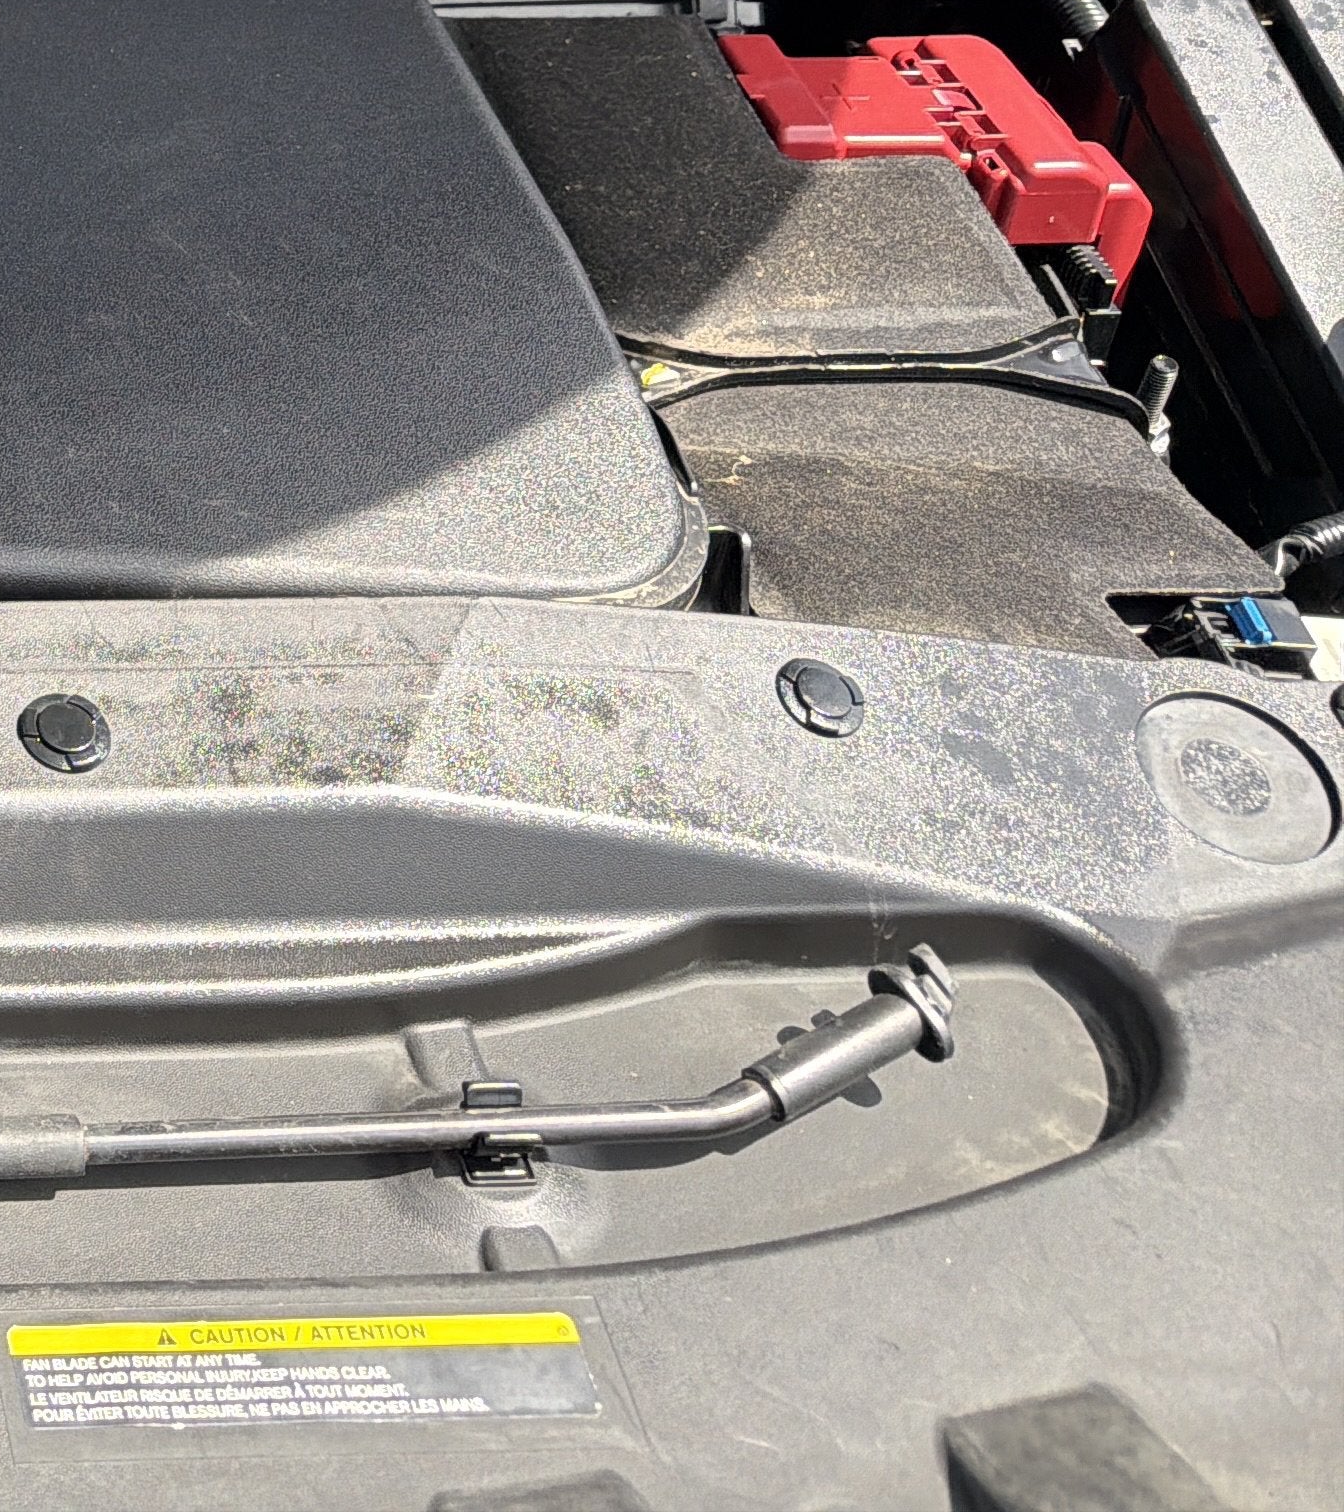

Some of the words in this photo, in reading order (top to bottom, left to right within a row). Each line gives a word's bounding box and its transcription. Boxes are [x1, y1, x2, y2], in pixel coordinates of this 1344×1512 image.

[190, 1327, 285, 1345] CAUTION
[294, 1327, 301, 1341] /
[312, 1323, 426, 1341] ATTENTION
[23, 1358, 50, 1371] FAN
[53, 1356, 96, 1371] BLADE
[99, 1356, 130, 1368] CAN
[132, 1356, 174, 1368] START
[177, 1356, 193, 1367] AT
[196, 1355, 224, 1367] ANY
[226, 1354, 261, 1366] TIME.
[26, 1375, 46, 1387] TO
[49, 1374, 82, 1387] HELP
[86, 1373, 128, 1386] AVOID
[131, 1370, 204, 1384] PERSONAL
[291, 1367, 339, 1380] HANDS
[341, 1366, 390, 1379] CLEAR.
[30, 1392, 47, 1406] LE
[50, 1389, 138, 1405] VENTILATEUR
[141, 1389, 192, 1402] RISQUE
[195, 1388, 214, 1401] DE
[217, 1384, 292, 1401] DÉMARRER
[307, 1384, 343, 1398] TOUT
[345, 1384, 409, 1398] MOMENT.
[33, 1409, 74, 1422] POUR
[77, 1405, 122, 1421] ÉVITER
[125, 1405, 170, 1420] TOUTE
[250, 1404, 270, 1417] NE
[272, 1403, 300, 1416] PAS
[302, 1401, 322, 1415] EN
[325, 1400, 411, 1415] APPROCHER
[412, 1399, 438, 1413] LES
